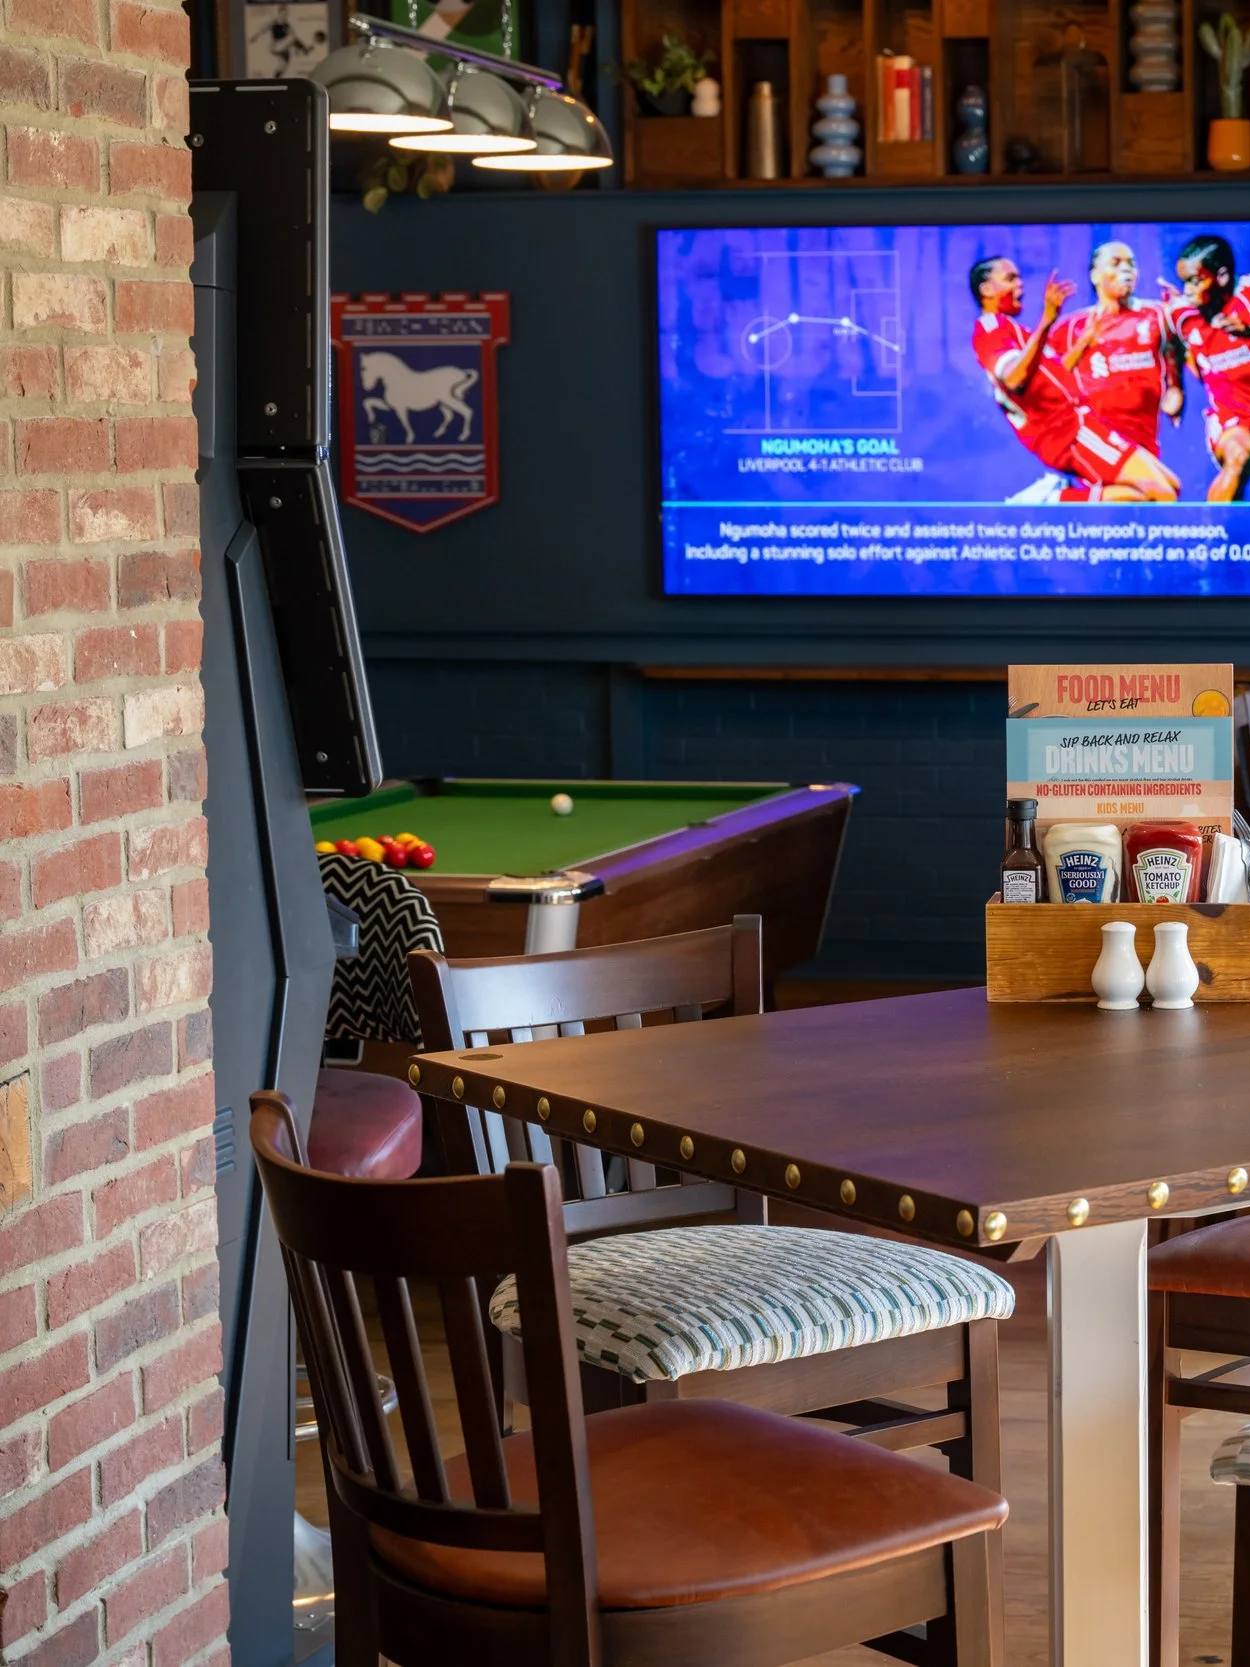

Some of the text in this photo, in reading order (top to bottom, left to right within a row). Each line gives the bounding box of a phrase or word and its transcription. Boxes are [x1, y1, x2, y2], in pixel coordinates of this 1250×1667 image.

[762, 438, 899, 455] NGUMOHA'S GOAL
[738, 458, 923, 472] LIVERPOOL 4-1 ATHLETIC CLUB
[719, 522, 1228, 542] Ngumoha scored twice and assisted twice during Liverpool's preseason,
[685, 544, 748, 564] including
[751, 548, 760, 560] a
[762, 545, 824, 564] stunning
[827, 544, 856, 560] solo
[859, 544, 902, 560] effort
[905, 545, 958, 564] against
[961, 544, 1016, 560] Athletic
[1020, 544, 1052, 560] Club
[1055, 544, 1085, 560] that
[1089, 545, 1163, 564] generated
[1166, 549, 1184, 560] an
[1187, 545, 1207, 560] xG
[1210, 544, 1227, 560] of
[1057, 674, 1181, 703] FOOD MENU
[1086, 698, 1142, 712] LET'S EAT
[1060, 731, 1181, 748] SIP BACK AND RELAX
[1045, 744, 1194, 774] DRINKS MENU
[1036, 783, 1202, 796] NO-GLUTEN CONTAINING INGREDIENTS
[1097, 802, 1144, 814] KIDS MENU
[1066, 855, 1099, 867] HEINZ
[1147, 856, 1178, 867] HEINZ
[1010, 873, 1029, 882] HEINZ
[1144, 872, 1181, 881] TOMATO
[1069, 880, 1097, 888] GOOD
[1146, 882, 1180, 890] KETCHUP
